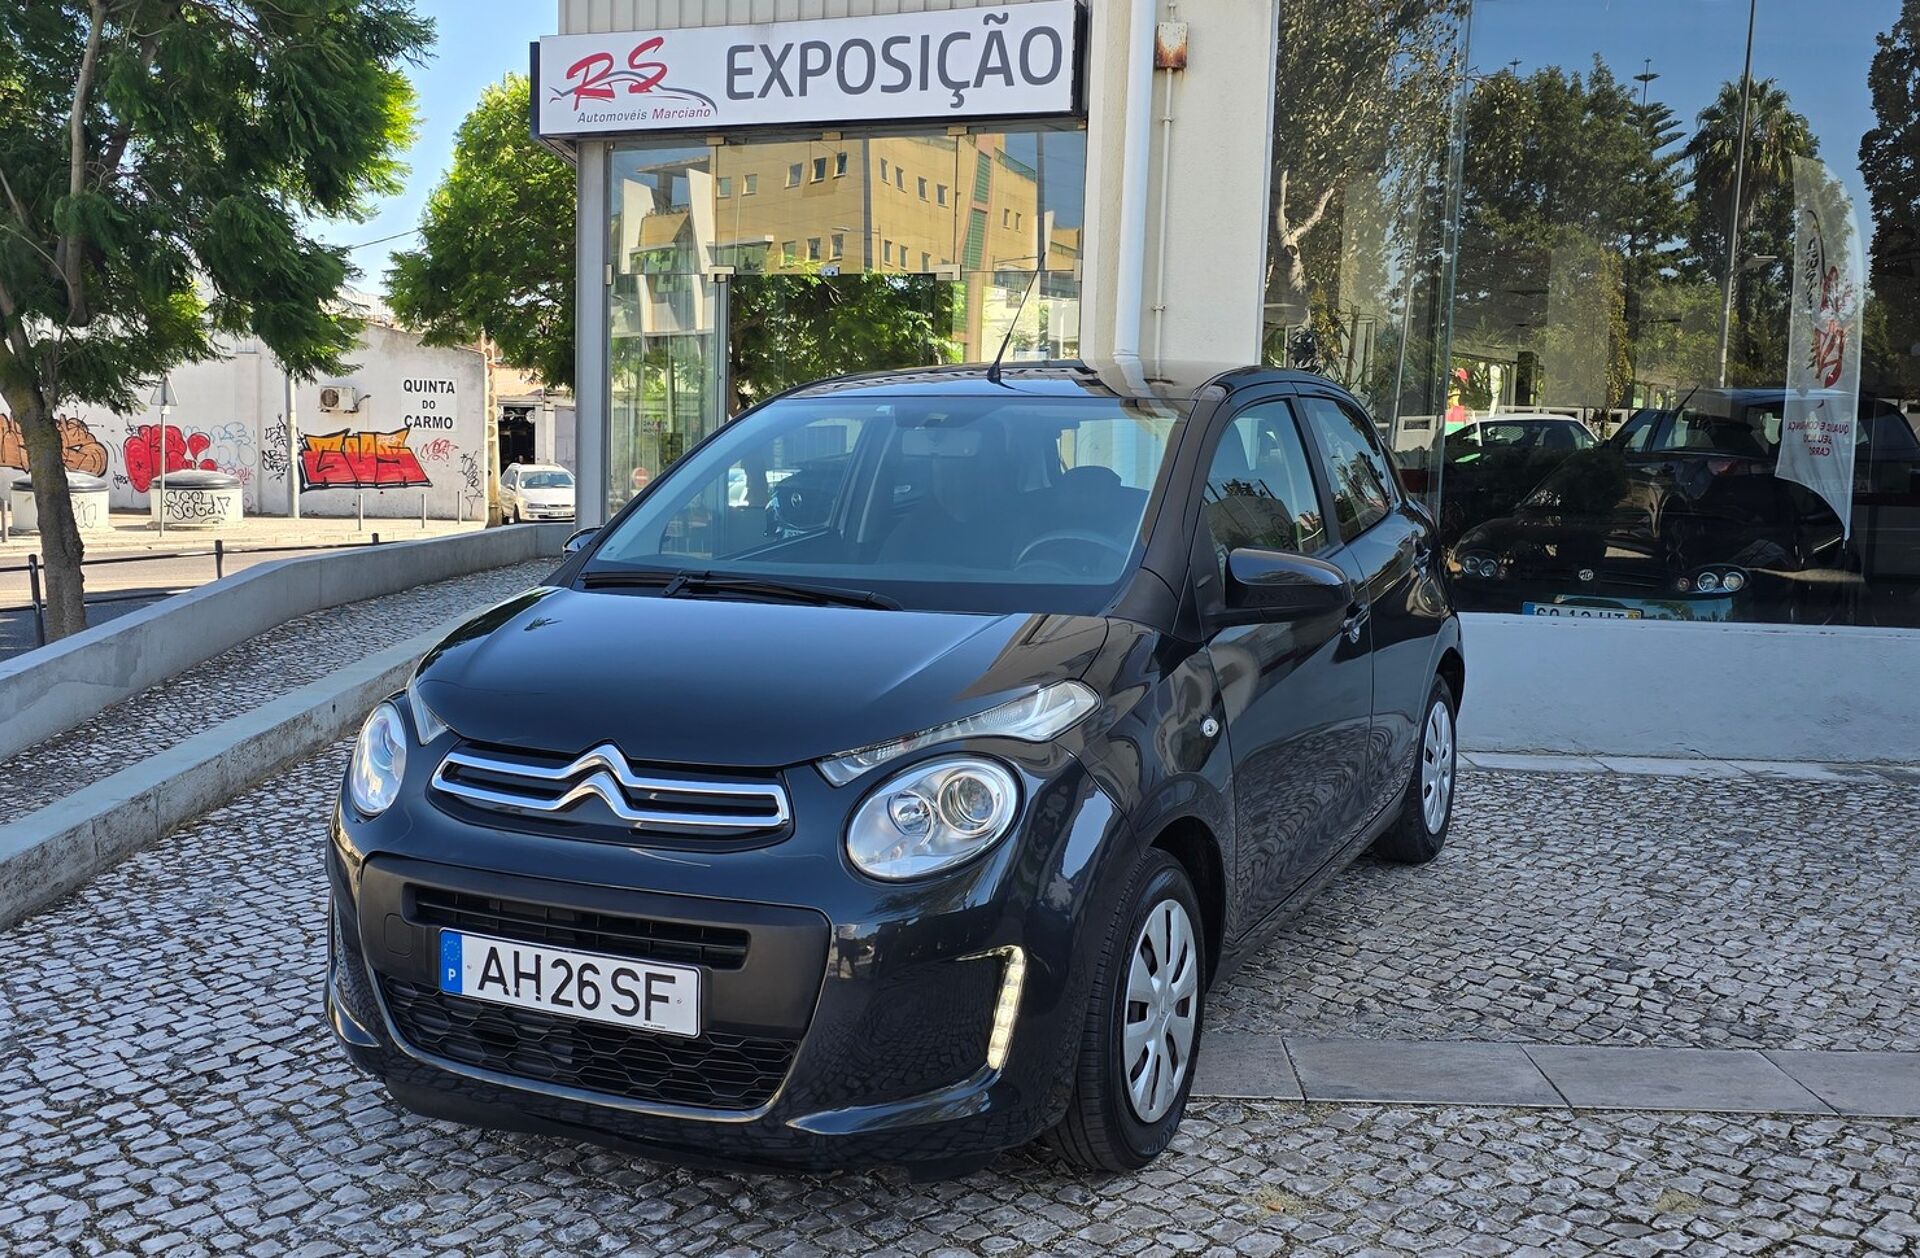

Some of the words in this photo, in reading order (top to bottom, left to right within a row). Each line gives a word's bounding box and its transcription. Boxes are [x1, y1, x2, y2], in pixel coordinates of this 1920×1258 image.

[726, 12, 1063, 109] EXPOSIÇÃO
[566, 36, 668, 112] RS
[577, 110, 648, 124] Automovéis
[651, 107, 711, 120] Marciano
[403, 379, 455, 394] QUINTA
[422, 400, 436, 409] DO
[404, 415, 454, 430] CARMO
[448, 968, 457, 981] P
